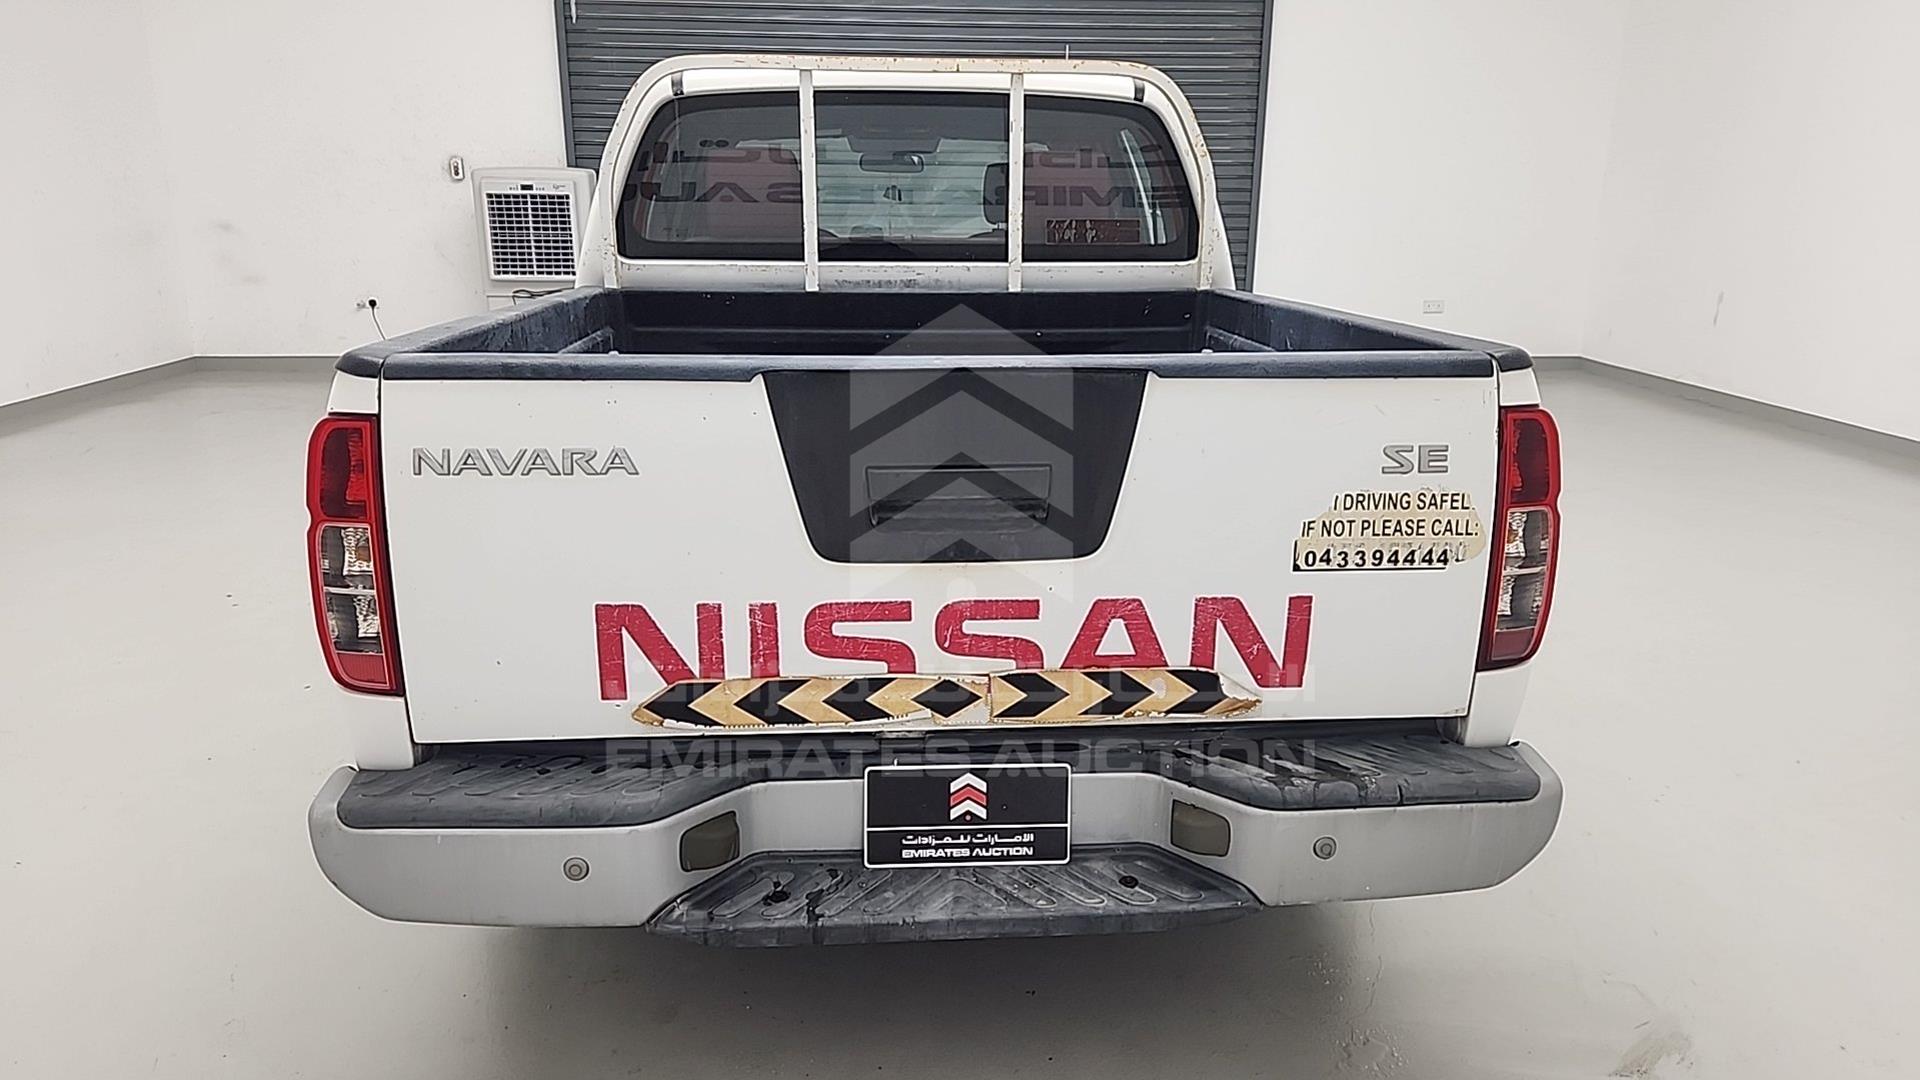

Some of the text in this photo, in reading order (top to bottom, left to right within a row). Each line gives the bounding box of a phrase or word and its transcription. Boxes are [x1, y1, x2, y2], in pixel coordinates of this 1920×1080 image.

[412, 448, 640, 476] NAVARA
[1381, 445, 1449, 474] SE
[1343, 492, 1411, 511] DRIVING
[1416, 492, 1476, 511] SAFEL
[1301, 518, 1479, 537] IF NOT PLEASE CALL:
[1304, 548, 1449, 567] 043394444
[595, 594, 1313, 701] NISSAN
[902, 846, 1034, 858] EMIRATES AUCTION
